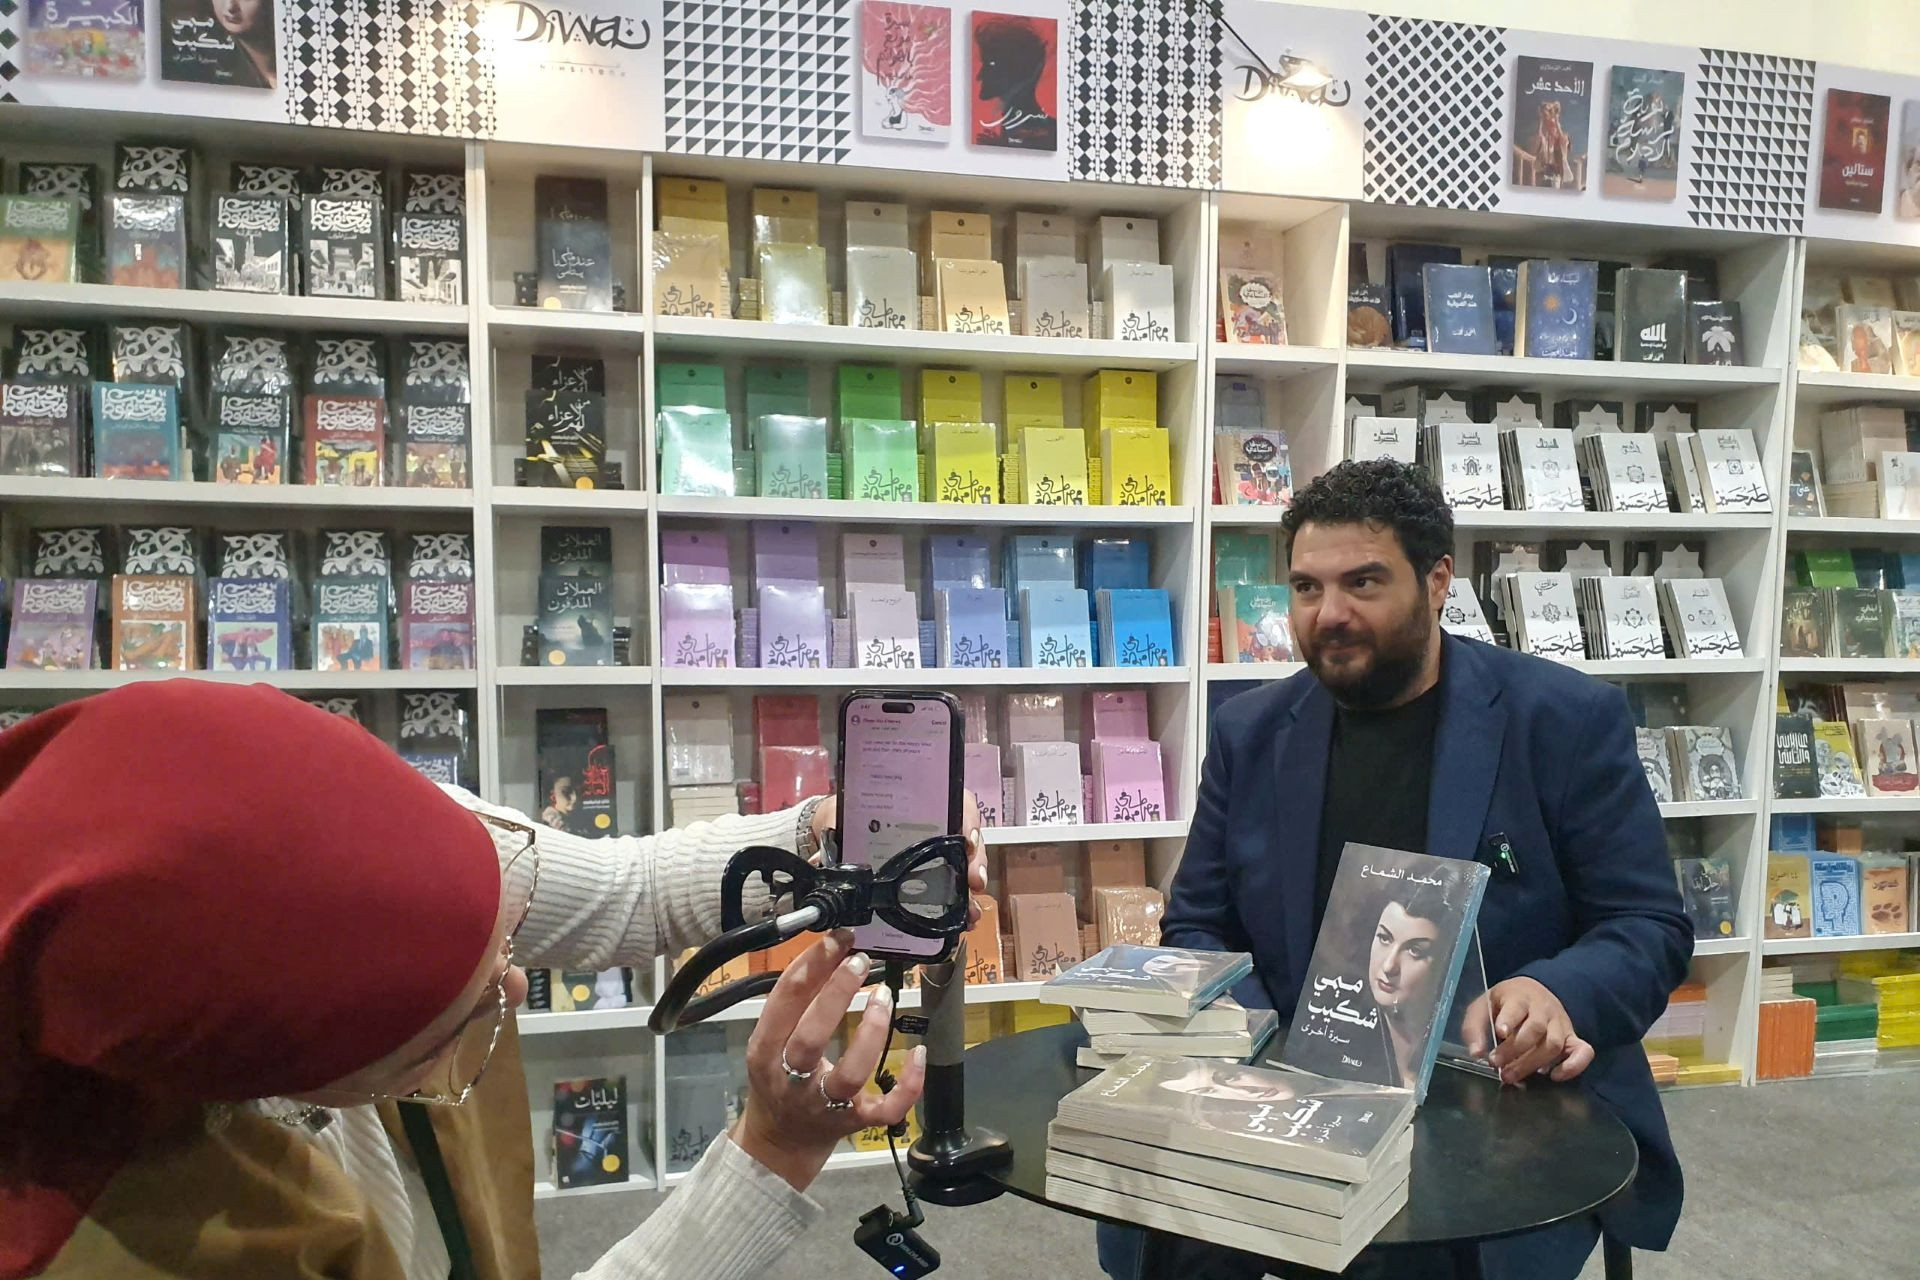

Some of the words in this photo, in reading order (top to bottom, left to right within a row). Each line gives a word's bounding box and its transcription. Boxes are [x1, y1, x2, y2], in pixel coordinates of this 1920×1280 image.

[172, 33, 235, 52] شكيب
[1525, 77, 1552, 95] عشر
[1555, 76, 1585, 97] الأحد
[1842, 160, 1874, 178] ستالين
[1640, 322, 1667, 342] الله
[557, 581, 602, 597] العملاق
[547, 596, 592, 613] المدفون
[1360, 863, 1404, 880] الشماع
[1406, 871, 1443, 887] محمد
[1313, 974, 1363, 997] ميمي
[1307, 998, 1378, 1030] شكيب
[1300, 1022, 1327, 1039] أخرى
[1327, 1028, 1351, 1044] سيرة
[1242, 1104, 1275, 1133] ميمي
[1281, 1098, 1324, 1138] شكيب
